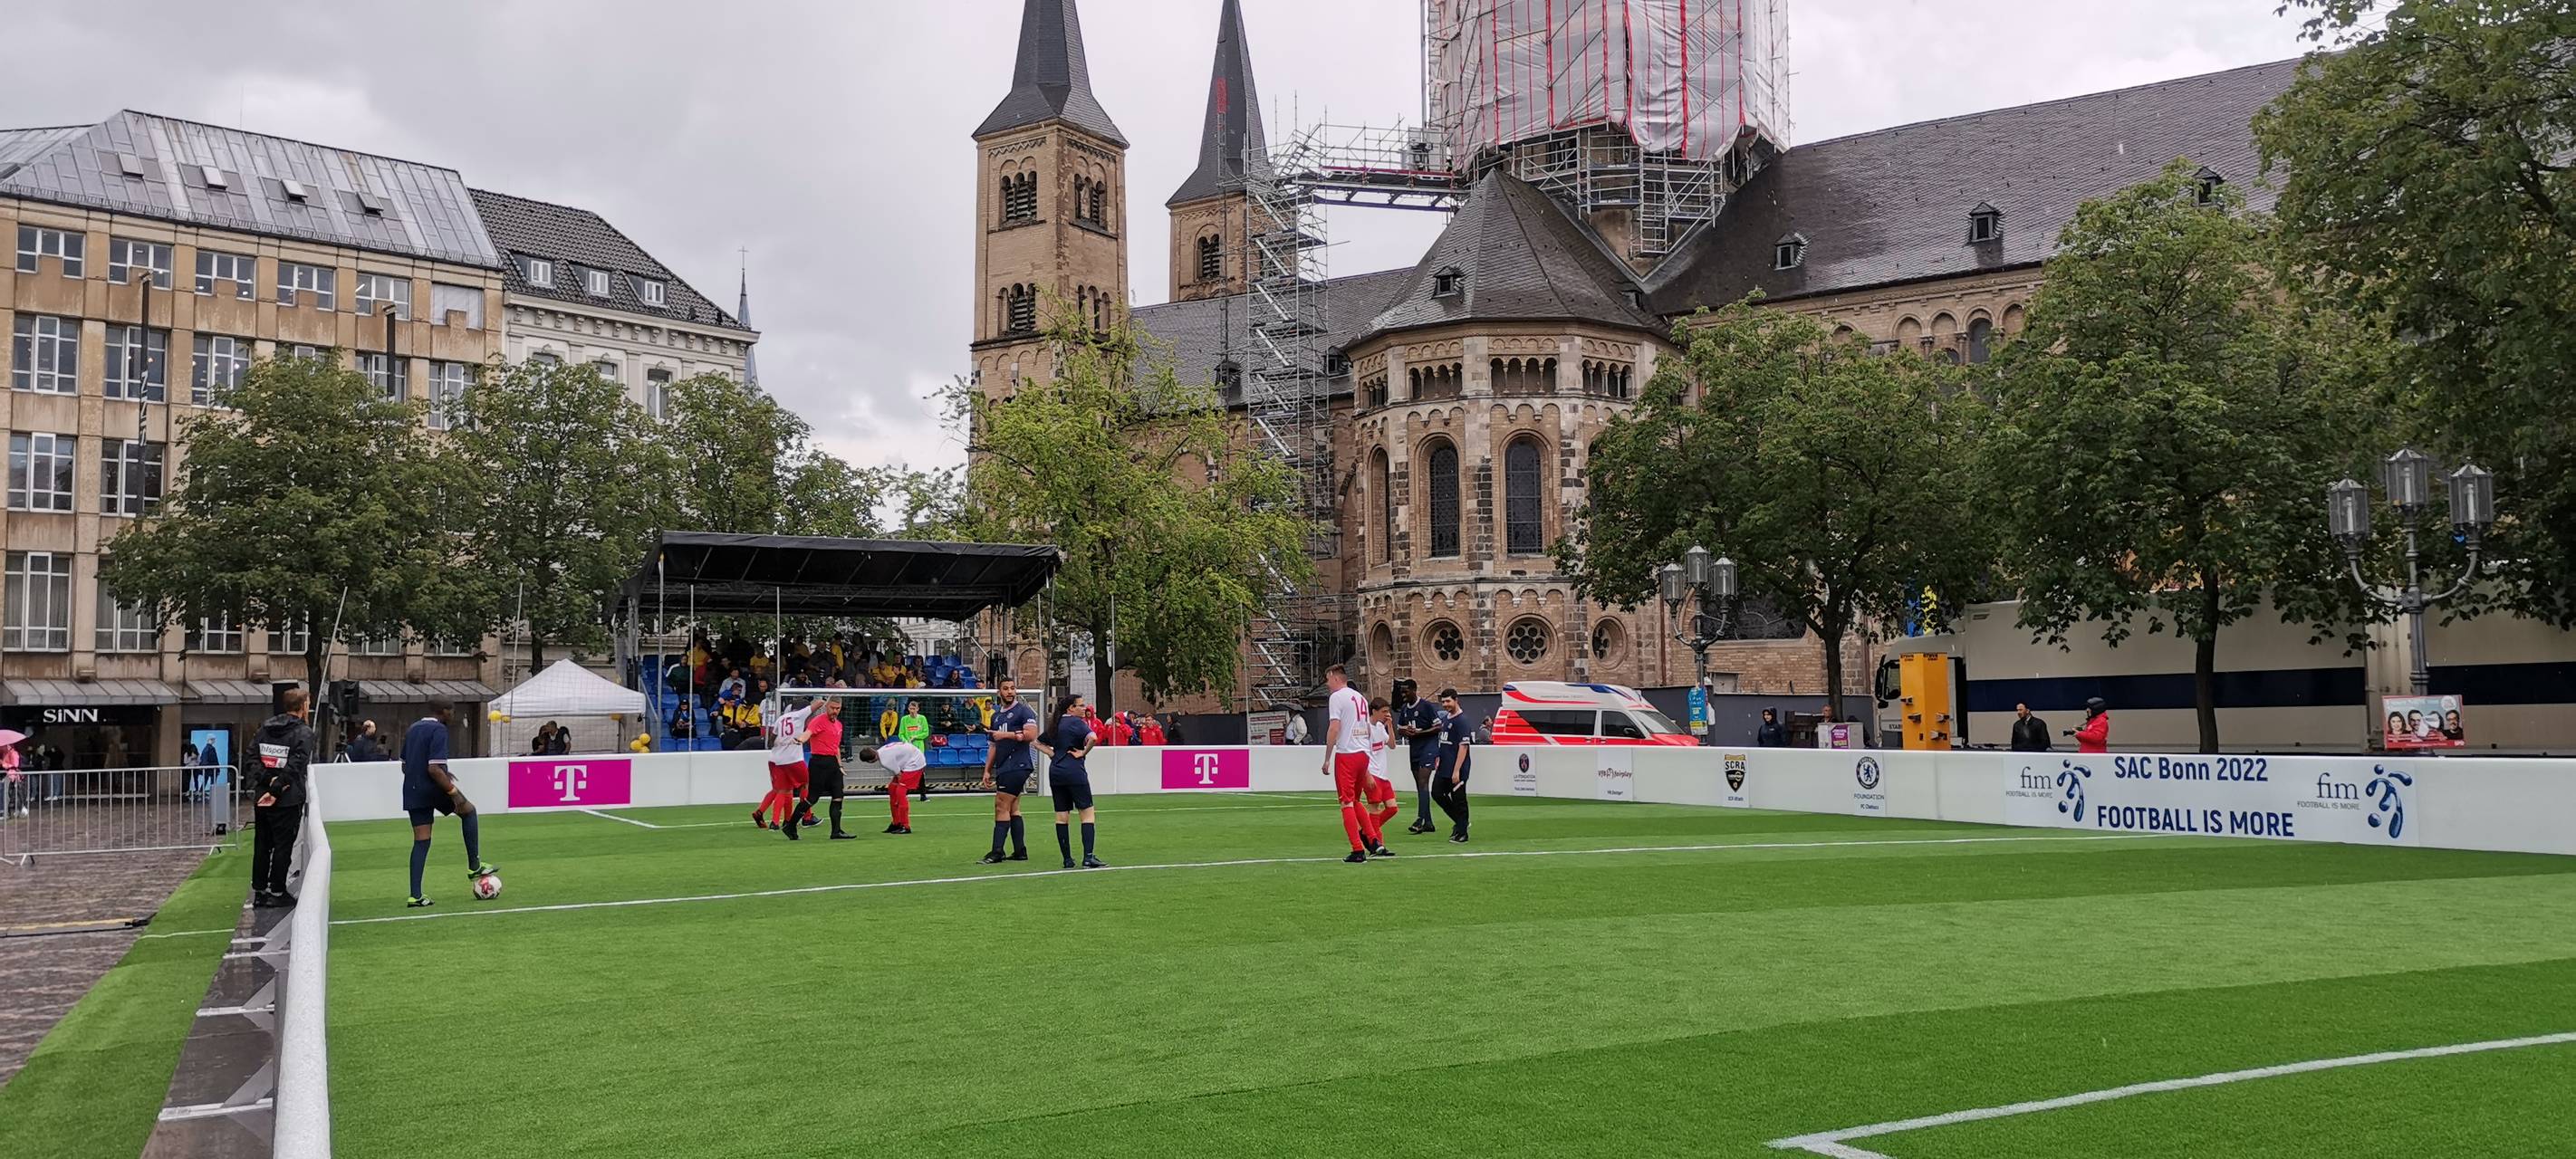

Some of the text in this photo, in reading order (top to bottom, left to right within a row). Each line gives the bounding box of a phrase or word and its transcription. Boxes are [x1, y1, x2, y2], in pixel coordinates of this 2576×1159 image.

[1350, 694, 1369, 723] 14
[780, 716, 794, 738] 15
[260, 744, 289, 755] hlsport
[1725, 761, 1745, 771] SCRA
[2114, 756, 2269, 781] SAC Bonn 2022
[2020, 766, 2052, 790] fim
[2316, 771, 2360, 800] fim
[1853, 792, 1885, 800] FOUNDATION
[2297, 800, 2331, 809] FOOTBALL
[2340, 802, 2360, 810] MORE
[2097, 805, 2295, 837] FOOTBALL IS MORE
